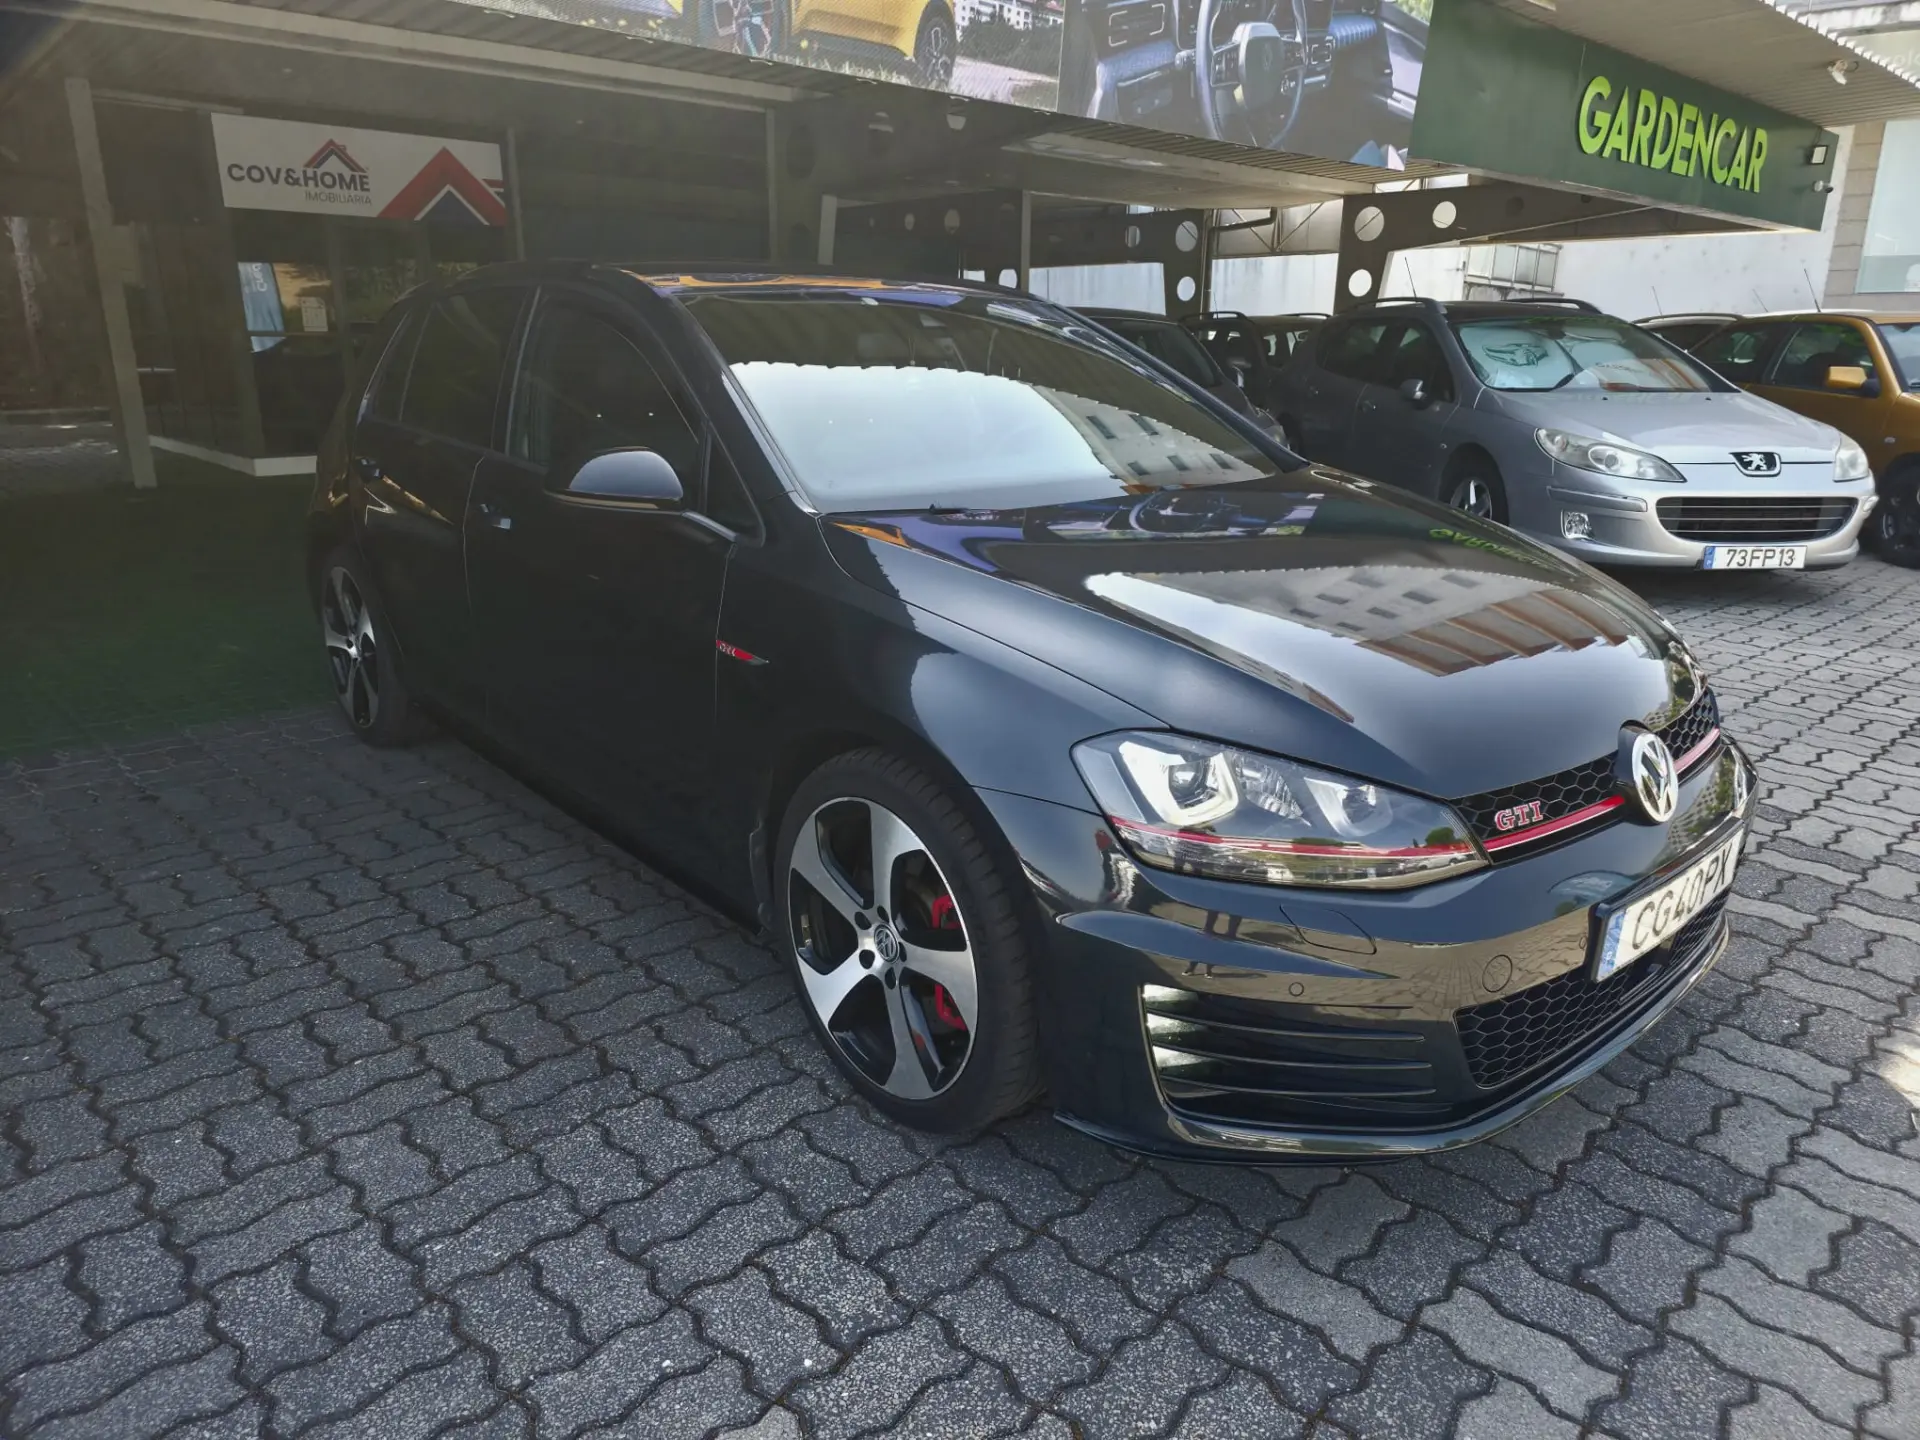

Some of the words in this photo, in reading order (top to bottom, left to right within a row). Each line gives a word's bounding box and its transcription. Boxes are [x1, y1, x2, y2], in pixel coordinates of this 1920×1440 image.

[1578, 75, 1769, 194] GARDENCAR
[227, 163, 371, 192] COV&HOME
[1725, 548, 1796, 567] 73FP13
[1494, 800, 1543, 831] GTI
[1632, 841, 1733, 950] CG40PX
